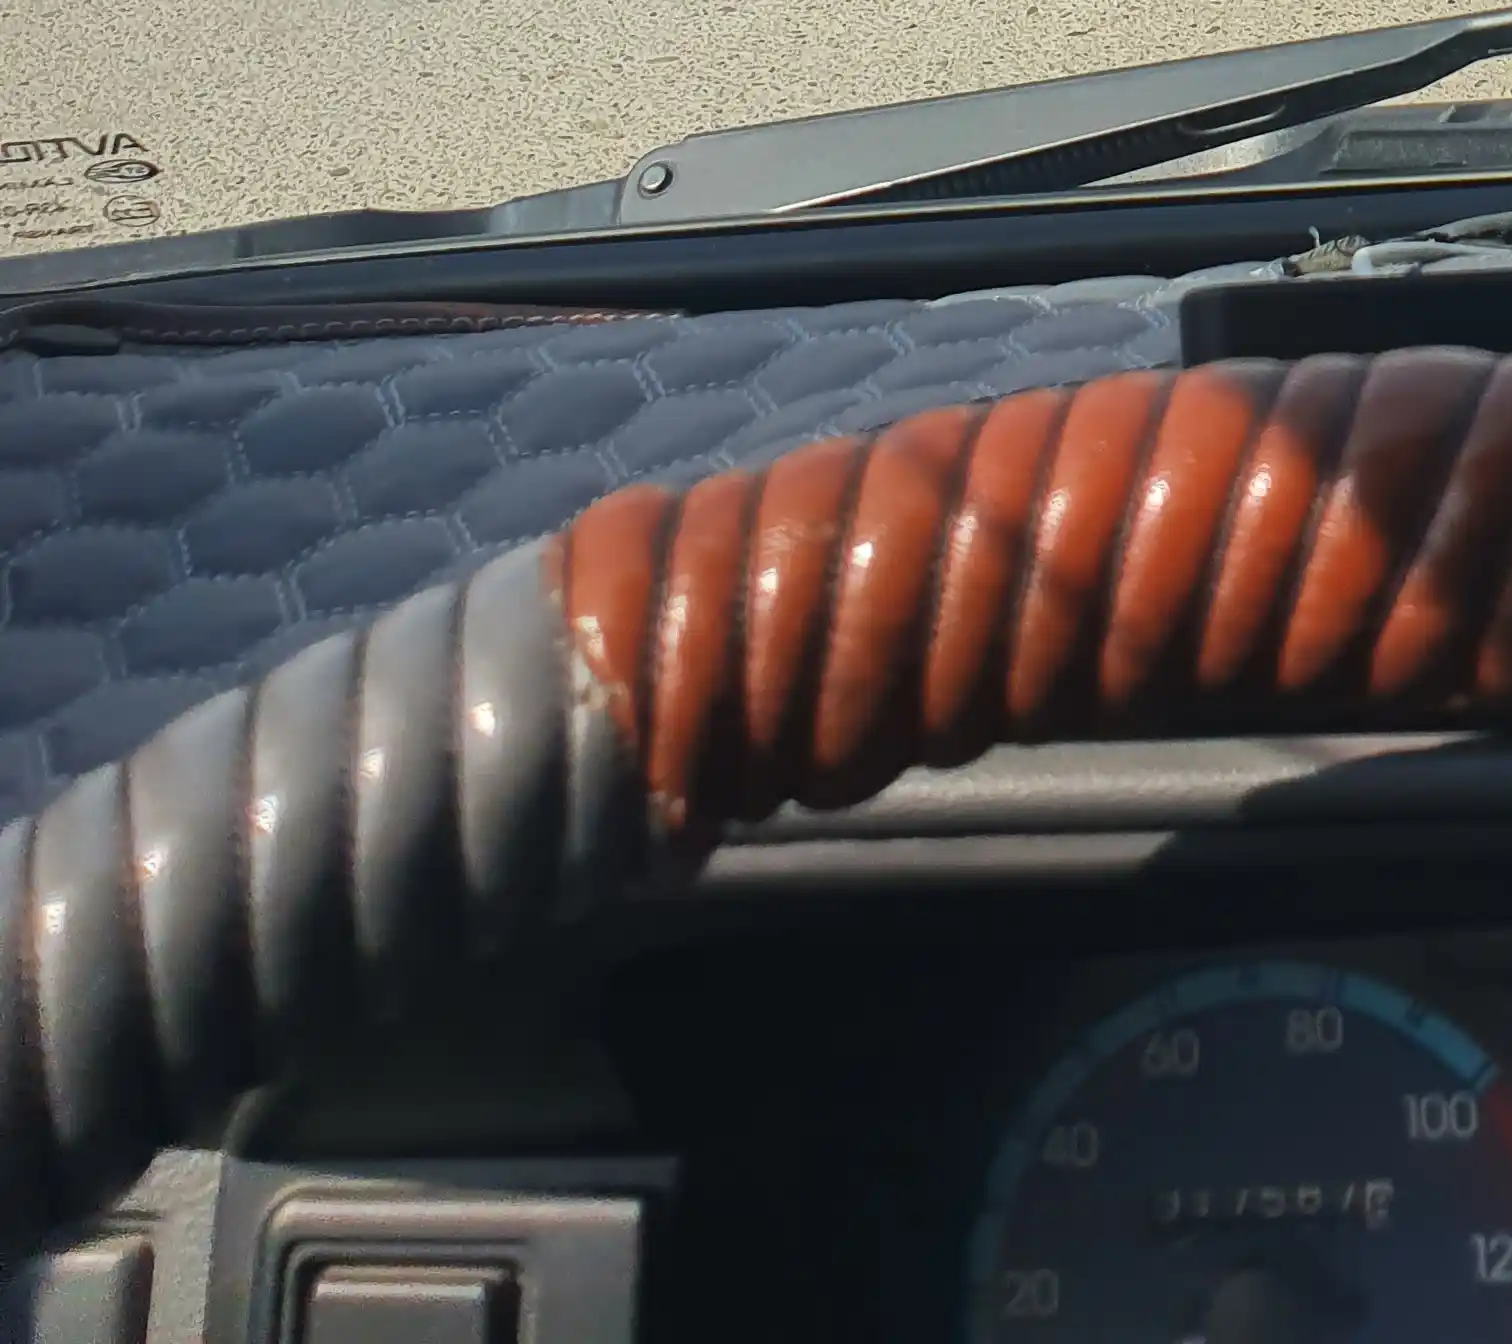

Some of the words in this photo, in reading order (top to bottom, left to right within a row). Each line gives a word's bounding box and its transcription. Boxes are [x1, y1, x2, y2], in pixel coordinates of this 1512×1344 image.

[1141, 1029, 1200, 1077] 60
[1285, 1006, 1343, 1054] 80
[1404, 1092, 1477, 1140] 100
[1041, 1123, 1099, 1168] 40
[1003, 1269, 1059, 1315] 20
